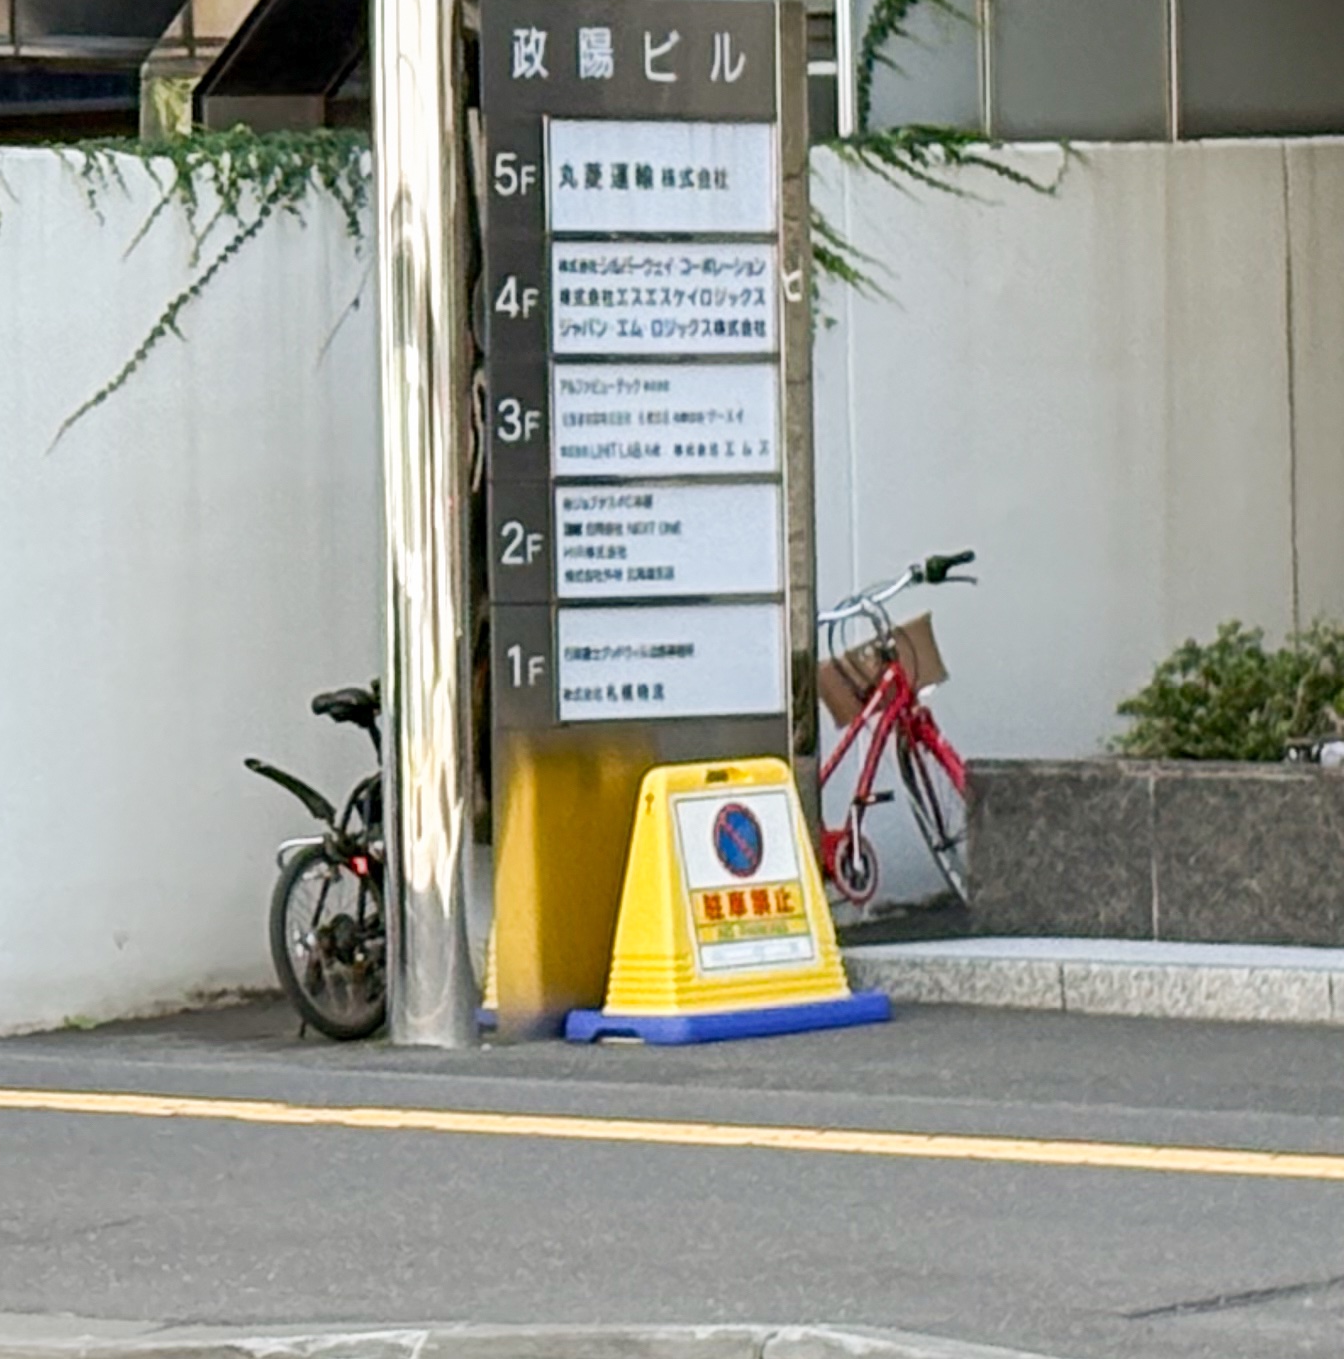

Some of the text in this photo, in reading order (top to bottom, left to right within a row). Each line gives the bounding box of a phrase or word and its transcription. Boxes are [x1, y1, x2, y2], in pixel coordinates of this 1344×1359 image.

[512, 26, 746, 83] 政陽ビル
[494, 153, 536, 196] 5F
[495, 276, 539, 320] 4F
[498, 399, 541, 442] 3F
[501, 521, 543, 565] 2F
[507, 645, 545, 687] 1F
